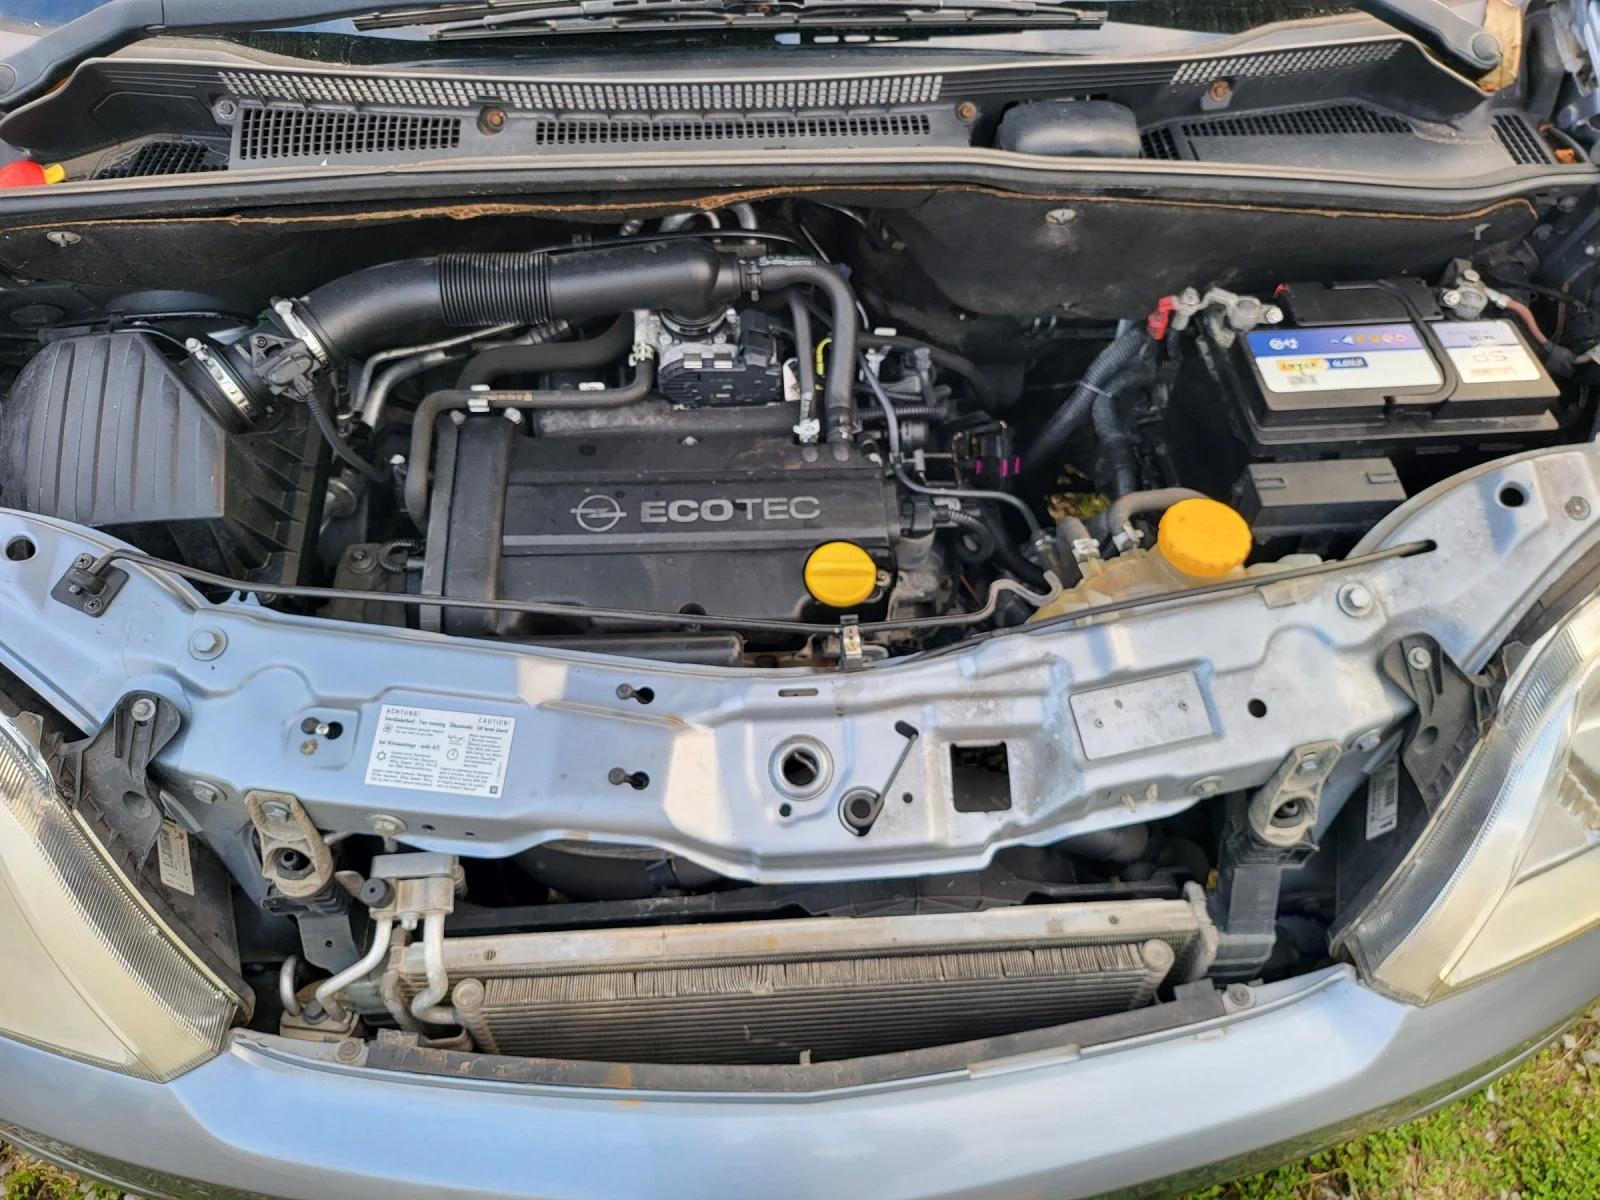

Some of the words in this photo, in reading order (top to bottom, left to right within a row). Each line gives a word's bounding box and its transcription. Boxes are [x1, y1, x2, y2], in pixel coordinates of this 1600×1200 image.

[640, 496, 821, 523] ECOTEC
[386, 708, 421, 717] ACHTUNG!
[478, 717, 511, 726] CAUTION!
